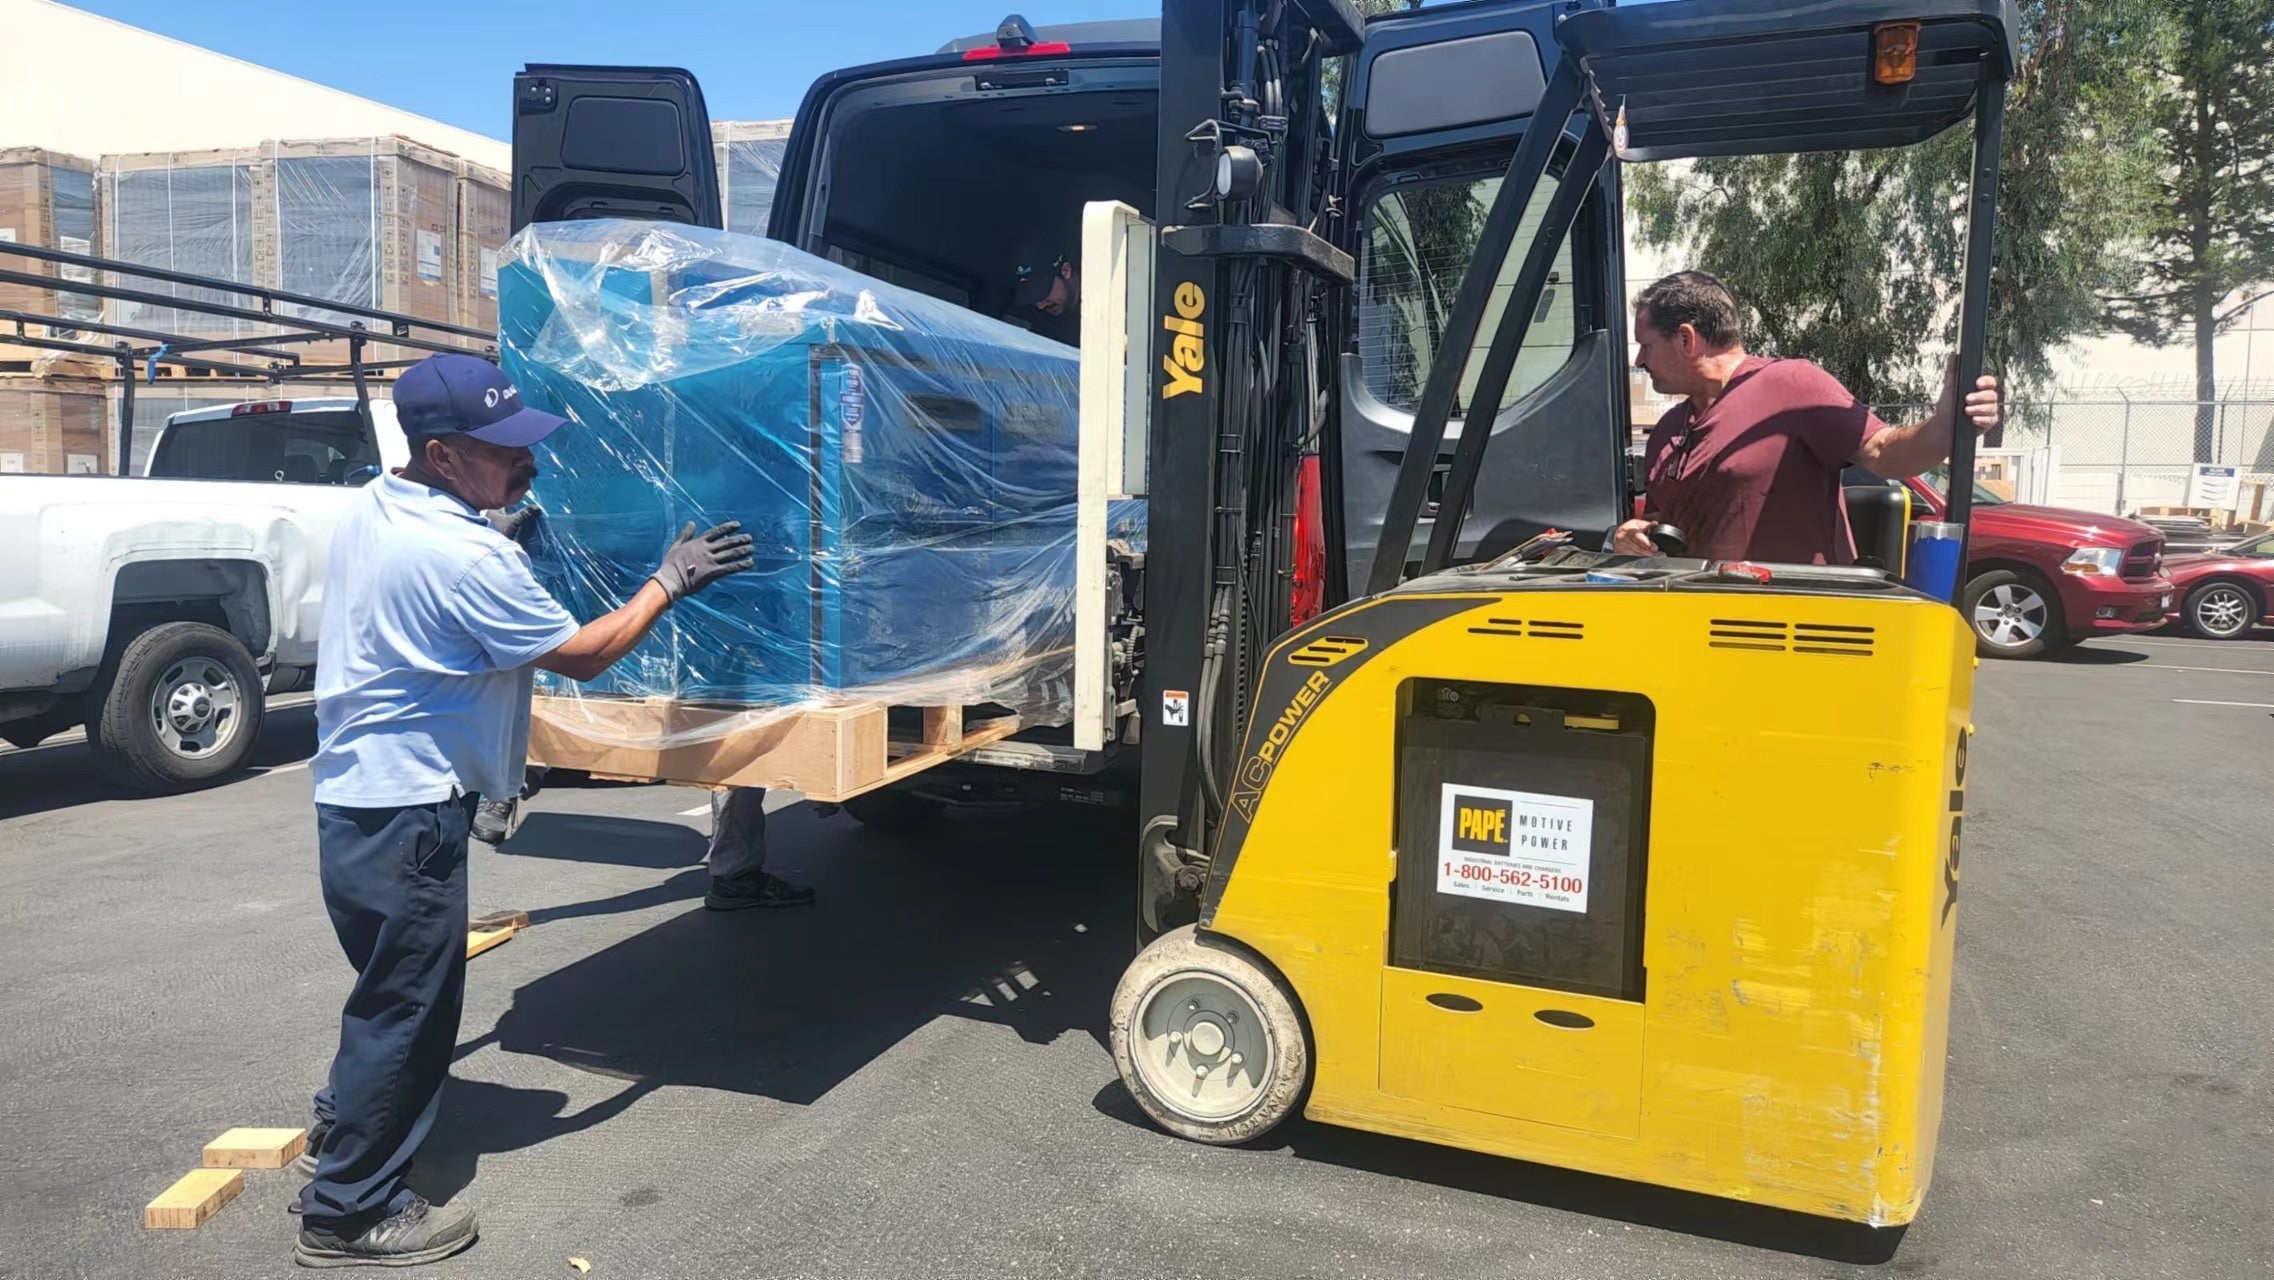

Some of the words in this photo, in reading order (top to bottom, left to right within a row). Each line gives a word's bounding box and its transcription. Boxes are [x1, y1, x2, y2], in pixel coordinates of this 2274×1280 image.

[1163, 281, 1205, 399] Yale
[1519, 814, 1573, 832] MOTIVE
[1941, 726, 1967, 931] Yale
[1521, 834, 1568, 851] POWER
[1444, 862, 1582, 894] 1-800-562-5100
[1453, 881, 1470, 889] Sales
[1481, 884, 1505, 893] Service
[1516, 889, 1533, 898] Parts
[1545, 893, 1570, 902] Rentals
